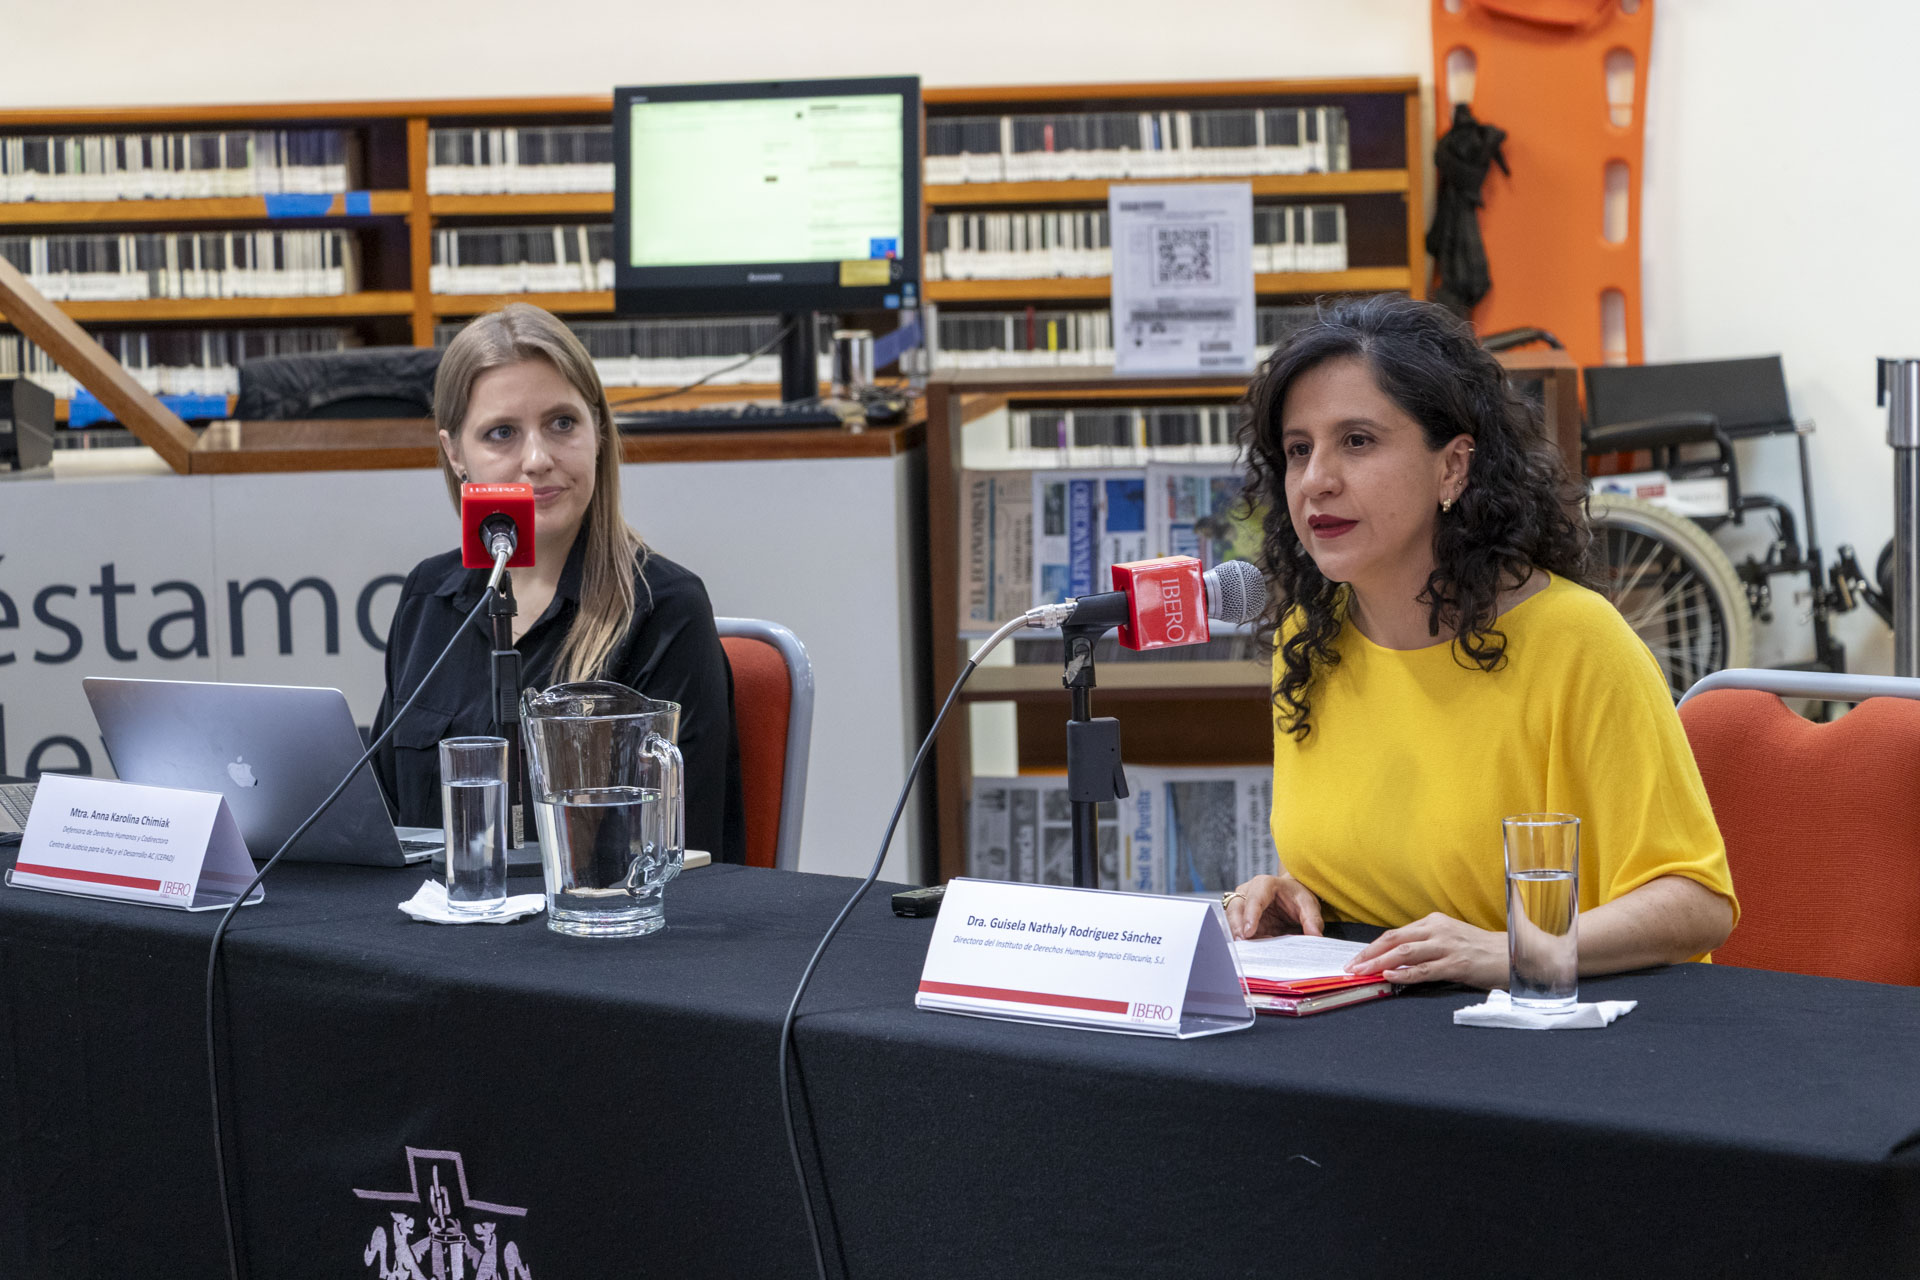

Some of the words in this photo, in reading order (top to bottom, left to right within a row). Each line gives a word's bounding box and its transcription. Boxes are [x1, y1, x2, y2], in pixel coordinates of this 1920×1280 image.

[0, 554, 406, 666] stamo
[1161, 578, 1185, 642] IBERO
[70, 808, 89, 818] Mtra.
[90, 810, 110, 820] Anna
[111, 812, 140, 824] Karolina
[141, 816, 170, 828] Chimiak
[62, 826, 85, 835] Defensora
[86, 828, 93, 836] de
[93, 829, 114, 838] Derechos
[115, 832, 136, 841] Humanos
[141, 835, 168, 844] Codirectora
[49, 840, 64, 848] Centro
[71, 843, 87, 852] Justicia
[88, 846, 100, 854] para
[123, 849, 147, 859] Desarrollo
[148, 852, 155, 860] AC
[163, 881, 191, 896] IBERO
[967, 915, 986, 927] Dra.
[990, 918, 1026, 931] Guisela
[1028, 922, 1067, 938] Nathaly
[1069, 926, 1119, 941] Rodríguez
[1121, 931, 1162, 945] Sánchez
[953, 936, 983, 946] Directora
[984, 938, 994, 946] del
[996, 940, 1023, 950] Instituto
[1033, 943, 1063, 954] Derechos
[1064, 947, 1096, 957] Humanos
[1097, 951, 1122, 960] Ignacio
[1132, 1002, 1173, 1021] IBERO
